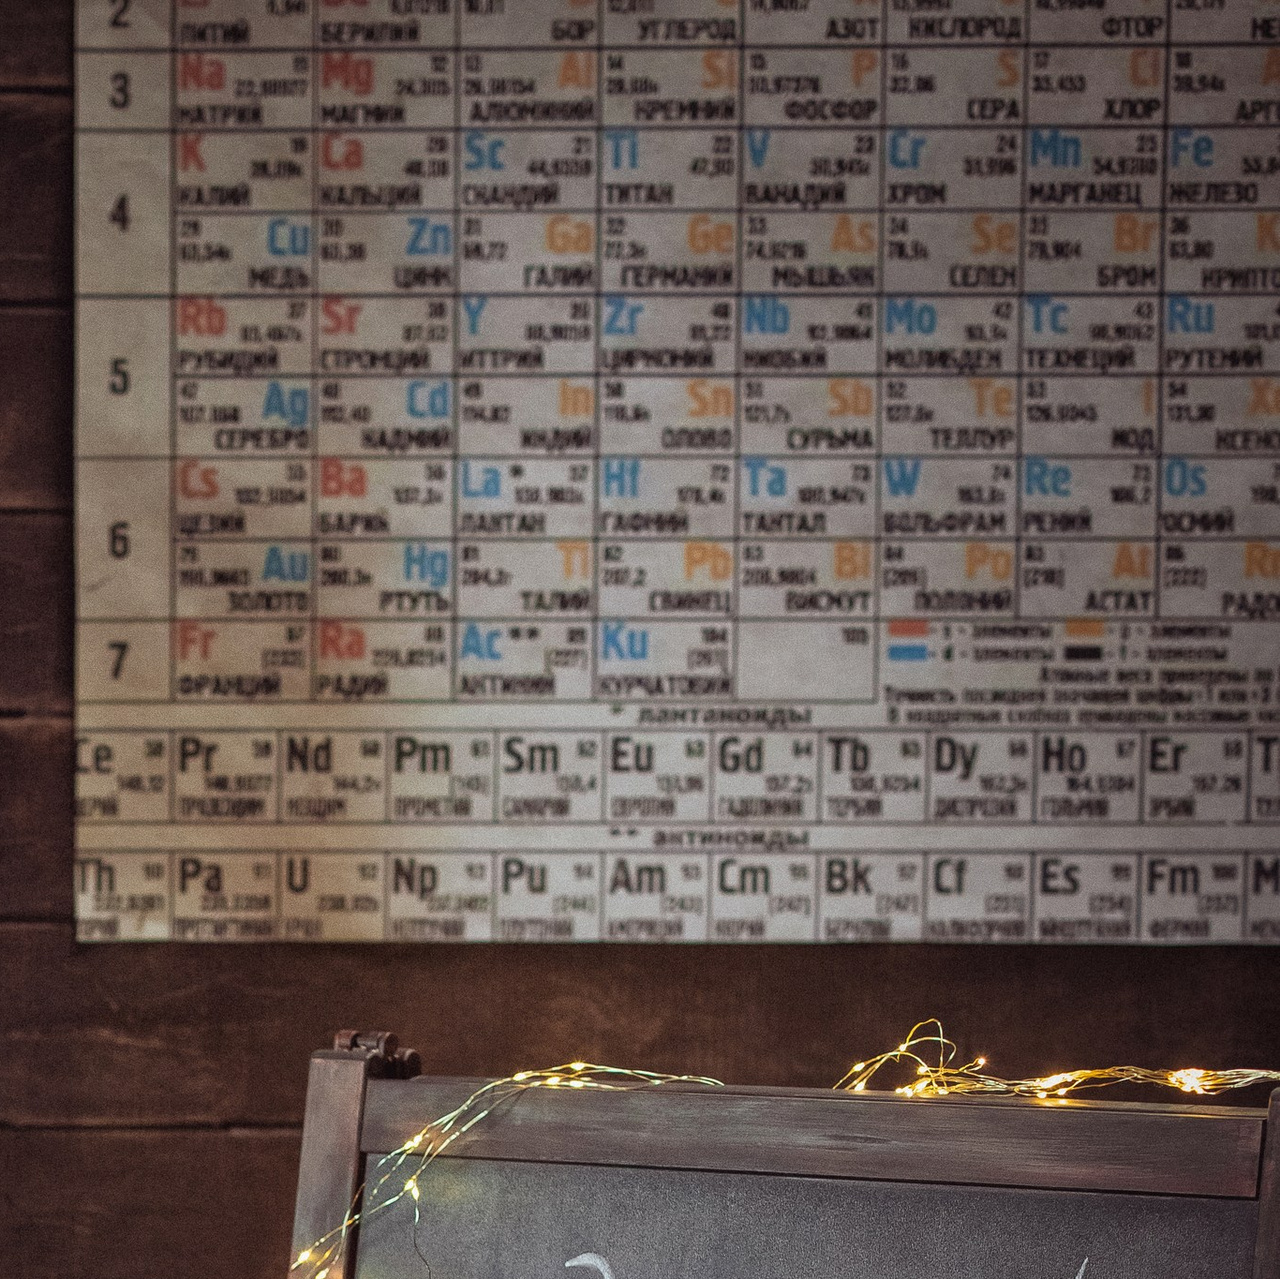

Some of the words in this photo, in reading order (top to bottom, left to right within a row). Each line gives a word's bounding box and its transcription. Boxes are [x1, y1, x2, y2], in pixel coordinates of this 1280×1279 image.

[551, 21, 594, 41] БОР
[638, 20, 736, 41] УГЛЕРОД
[826, 19, 878, 38] АЗОТ
[909, 18, 1021, 41] КИСЛОРОД
[1102, 16, 1162, 37] ФТОР
[179, 52, 226, 90] Na
[322, 52, 373, 95] Mg
[558, 52, 594, 89] Al
[702, 49, 735, 89] Si
[851, 51, 876, 88] P
[997, 49, 1019, 87] S
[1128, 49, 1160, 87] Cl
[109, 72, 130, 108] 3
[177, 102, 263, 124] НАТРИЙ
[322, 102, 405, 123] МАГНИЙ
[471, 97, 594, 121] АЛЮМИНИЙ
[635, 98, 735, 119] КРЕМНИЙ
[784, 101, 877, 120] ФОСФОР
[967, 100, 1020, 119] СЕРА
[1103, 99, 1162, 119] ХЛОР
[180, 133, 205, 172] K
[322, 133, 363, 170] Ca
[465, 130, 504, 171] Sc
[606, 130, 638, 170] Ti
[746, 130, 770, 168] V
[890, 130, 926, 168] Cr
[1031, 130, 1081, 167] Mn
[1171, 126, 1213, 167] Fe
[179, 184, 250, 206] КАЛИЙ
[321, 184, 422, 210] КАЛЬЦИЙ
[462, 182, 558, 211] СКАНДИЙ
[606, 184, 674, 203] ТИТАН
[745, 182, 846, 210] ВАНАДИЙ
[889, 184, 946, 202] ХРОМ
[1029, 184, 1142, 208] МАРГАНЕЦ
[1170, 183, 1258, 202] ЖЕЛЕЗО
[109, 196, 130, 231] 4
[268, 219, 310, 255] Cu
[406, 218, 451, 255] Zn
[546, 215, 592, 253] Ga
[687, 214, 733, 253] Ge
[831, 213, 875, 253] As
[972, 215, 1016, 254] Se
[1114, 213, 1159, 253] Br
[249, 267, 310, 289] МЕДЬ
[394, 267, 452, 289] ЦИНК
[622, 264, 733, 286] ГЕРМАНИЙ
[771, 267, 875, 287] МЫШЬЯК
[949, 266, 1016, 287] СЕЛЕН
[1097, 266, 1156, 286] БРОМ
[1202, 268, 1280, 287] КРИПТО
[178, 295, 226, 336] Rb
[322, 295, 360, 334] Sr
[463, 295, 487, 334] Y
[604, 295, 644, 335] Zr
[745, 294, 790, 334] Nb
[886, 298, 937, 334] Mo
[1027, 295, 1069, 333] Tc
[1168, 295, 1214, 332] Ru
[178, 348, 278, 374] РУБИДИЙ
[321, 347, 429, 372] СТРОНЦИЙ
[886, 348, 1002, 374] МОЛИБДЕН
[1027, 347, 1134, 374] ТЕХНЕЦИЙ
[1167, 347, 1263, 369] РУТЕНИЙ
[109, 359, 130, 395] 5
[262, 382, 308, 425] Ag
[407, 382, 449, 417] Cd
[558, 380, 594, 416] In
[687, 379, 733, 417] Sn
[827, 378, 873, 417] Sb
[969, 380, 1014, 417] Te
[215, 429, 308, 449] СЕРЕБРО
[362, 429, 450, 451] КАДМИЙ
[521, 429, 592, 452] ИНДИЙ
[662, 429, 731, 449] ОЛОВО
[788, 429, 873, 449] СУРЬМА
[930, 429, 1015, 448] ТЕЛЛУР
[1216, 430, 1280, 449] КСЕНО
[179, 460, 219, 498] Cs
[321, 459, 367, 497] Ba
[462, 460, 501, 497] La
[604, 459, 639, 497] Hf
[744, 459, 787, 496] Ta
[886, 459, 921, 496] W
[1024, 458, 1072, 496] Re
[1166, 459, 1207, 496] Os
[461, 513, 545, 533] ЛАНТАН
[601, 506, 688, 533] ГАФНИЙ
[744, 514, 826, 532] ТАНТАЛ
[885, 512, 1005, 532] ВОЛЬФРАМ
[109, 522, 130, 558] 6
[262, 546, 308, 581] Au
[404, 544, 448, 586] Hg
[684, 541, 731, 579] Pb
[834, 541, 870, 579] Bi
[965, 542, 1013, 579] Po
[1113, 542, 1149, 578] At
[228, 591, 308, 611] ЗОЛОТО
[381, 591, 449, 612] РТУТЬ
[649, 591, 730, 614] СВИНЕЦ
[786, 592, 870, 612] ВИСМУТ
[1085, 592, 1152, 611] АСТАТ
[1223, 593, 1280, 619] РАДО
[178, 620, 217, 660] Fr
[321, 621, 366, 659] Ra
[461, 623, 502, 659] Ac
[603, 621, 648, 659] Ku
[108, 641, 129, 679] 7
[319, 674, 388, 697] РАДИЙ
[639, 706, 812, 729] лантаноиды
[179, 737, 219, 773] Pr
[286, 737, 332, 773] Nd
[395, 737, 450, 773] Pm
[503, 737, 559, 773] Sm
[611, 737, 653, 773] Eu
[720, 737, 763, 773] Gd
[827, 737, 868, 773] Tb
[935, 737, 977, 779] Dy
[1043, 737, 1086, 773] Ho
[1149, 737, 1187, 773] Er
[76, 858, 114, 892] Th
[180, 858, 222, 892] Pa
[287, 858, 308, 892] U
[394, 858, 437, 900] Np
[502, 858, 547, 893] Pu
[610, 860, 666, 893] Am
[719, 859, 770, 893] Cm
[826, 858, 871, 894] Bk
[934, 859, 967, 893] Cf
[1040, 859, 1079, 893] Es
[1148, 859, 1200, 893] Fm
